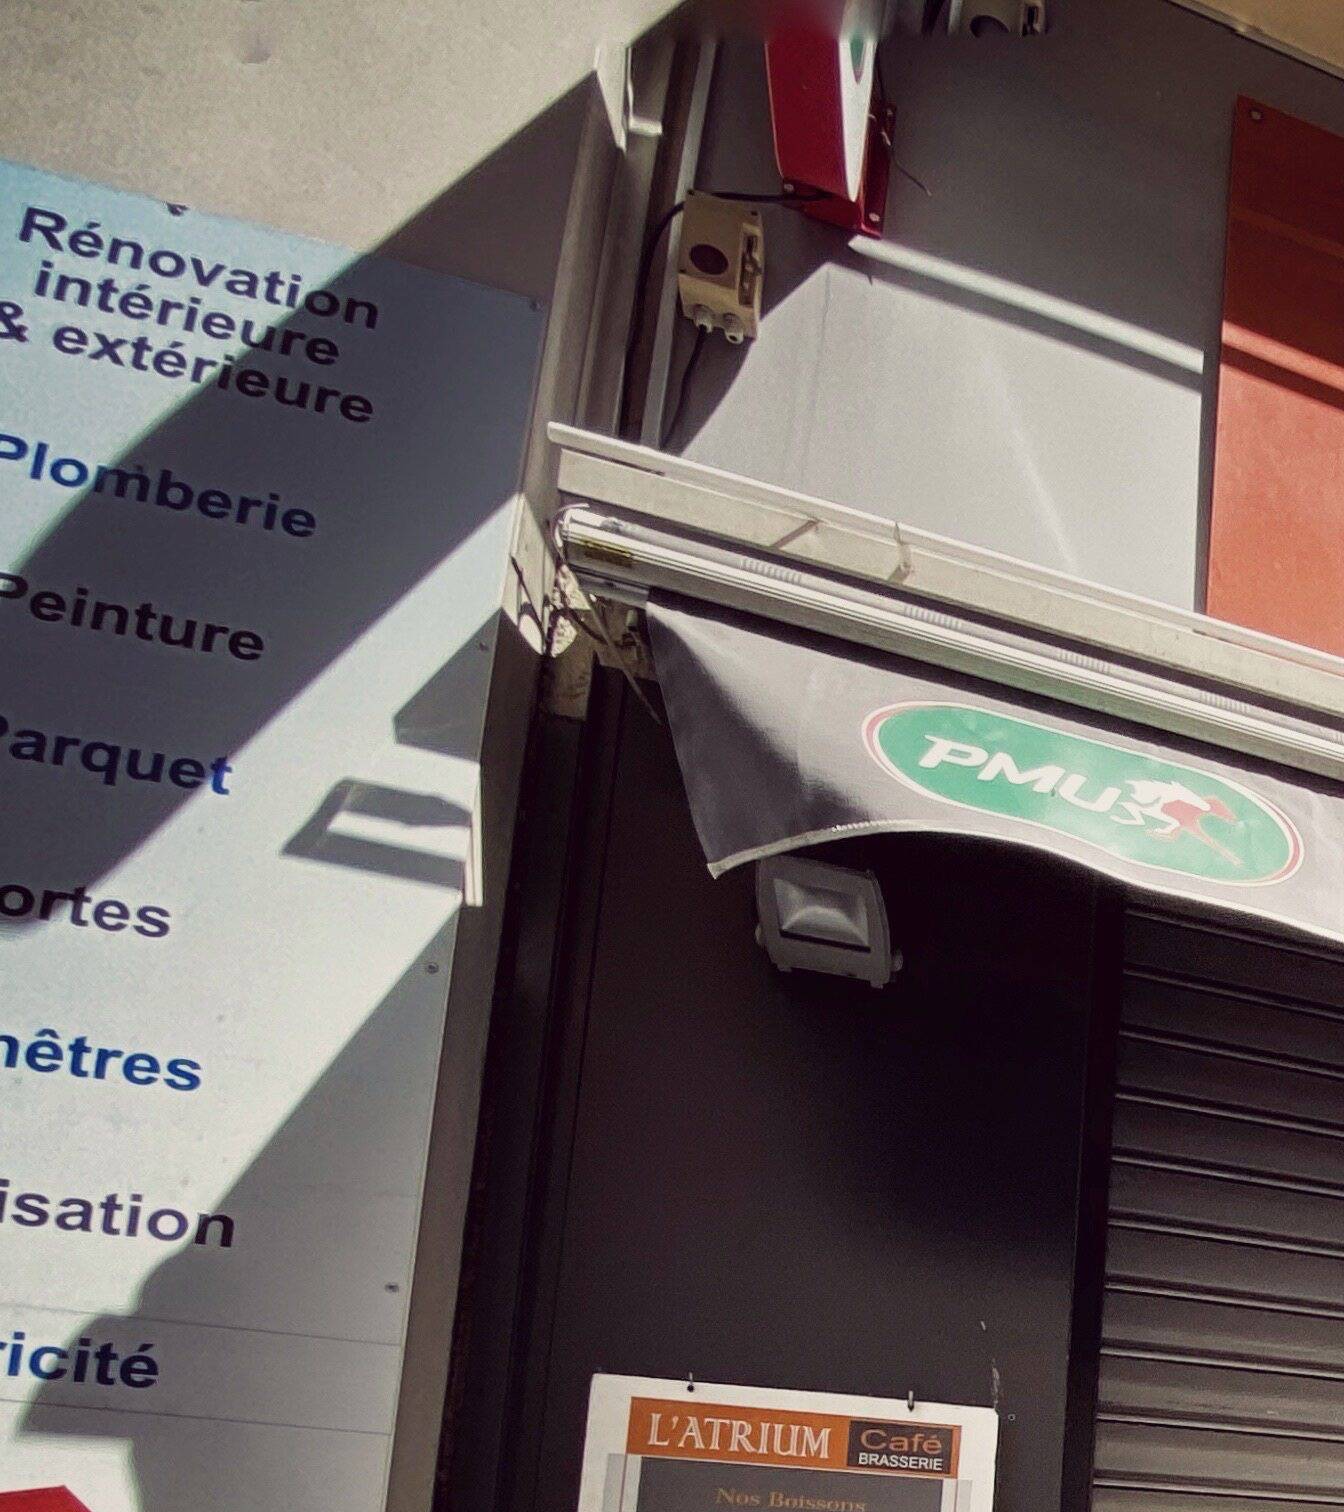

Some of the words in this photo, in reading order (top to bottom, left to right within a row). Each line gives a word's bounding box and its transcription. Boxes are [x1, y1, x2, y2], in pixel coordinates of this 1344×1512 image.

[19, 206, 379, 329] Rénovation
[34, 261, 340, 366] intérieure
[53, 324, 374, 423] extérieure
[918, 734, 1124, 812] PMU
[0, 1331, 159, 1388] icité
[648, 1412, 831, 1459] L'ATRIUM
[860, 1428, 942, 1455] Café
[858, 1452, 943, 1471] BRASSERIE
[715, 1487, 760, 1507] Nos
